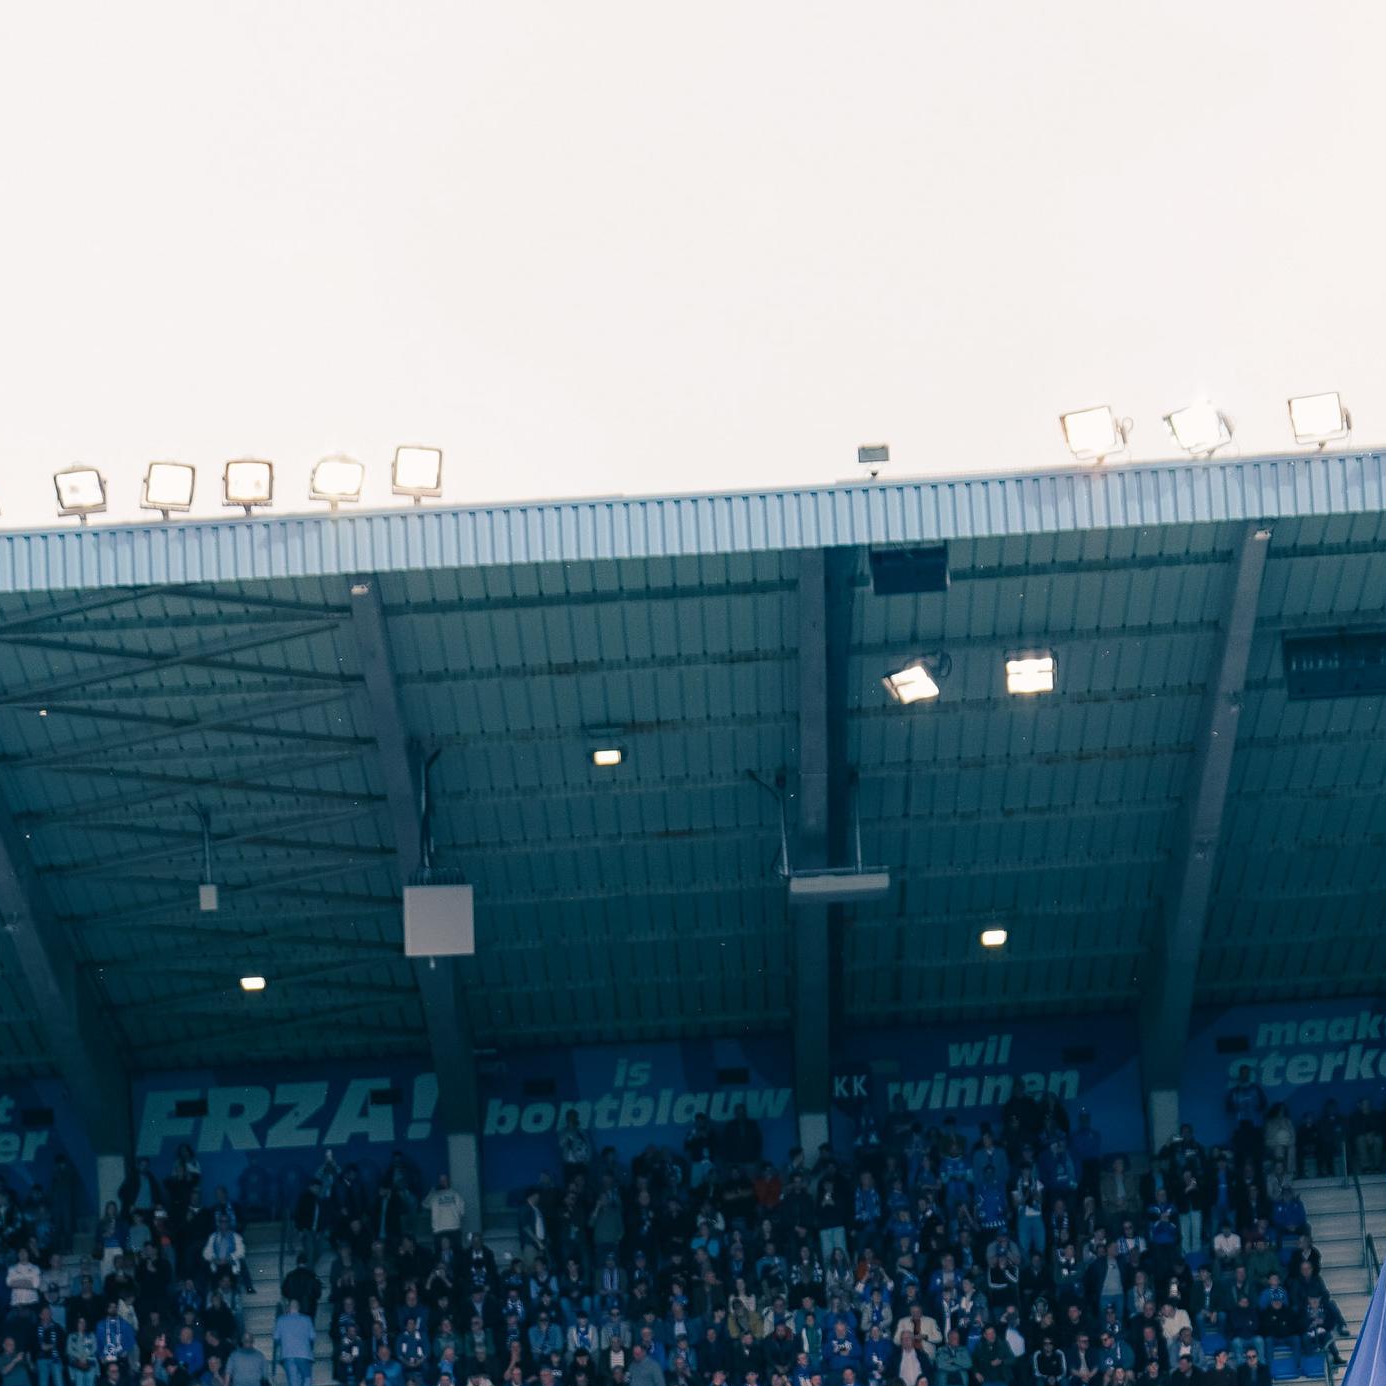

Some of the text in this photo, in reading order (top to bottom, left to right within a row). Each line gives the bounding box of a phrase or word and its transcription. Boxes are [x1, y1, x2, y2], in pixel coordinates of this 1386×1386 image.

[948, 1034, 1013, 1068] wil
[615, 1058, 653, 1087] is
[833, 1075, 868, 1098] KK
[136, 1072, 439, 1157] FRZA!
